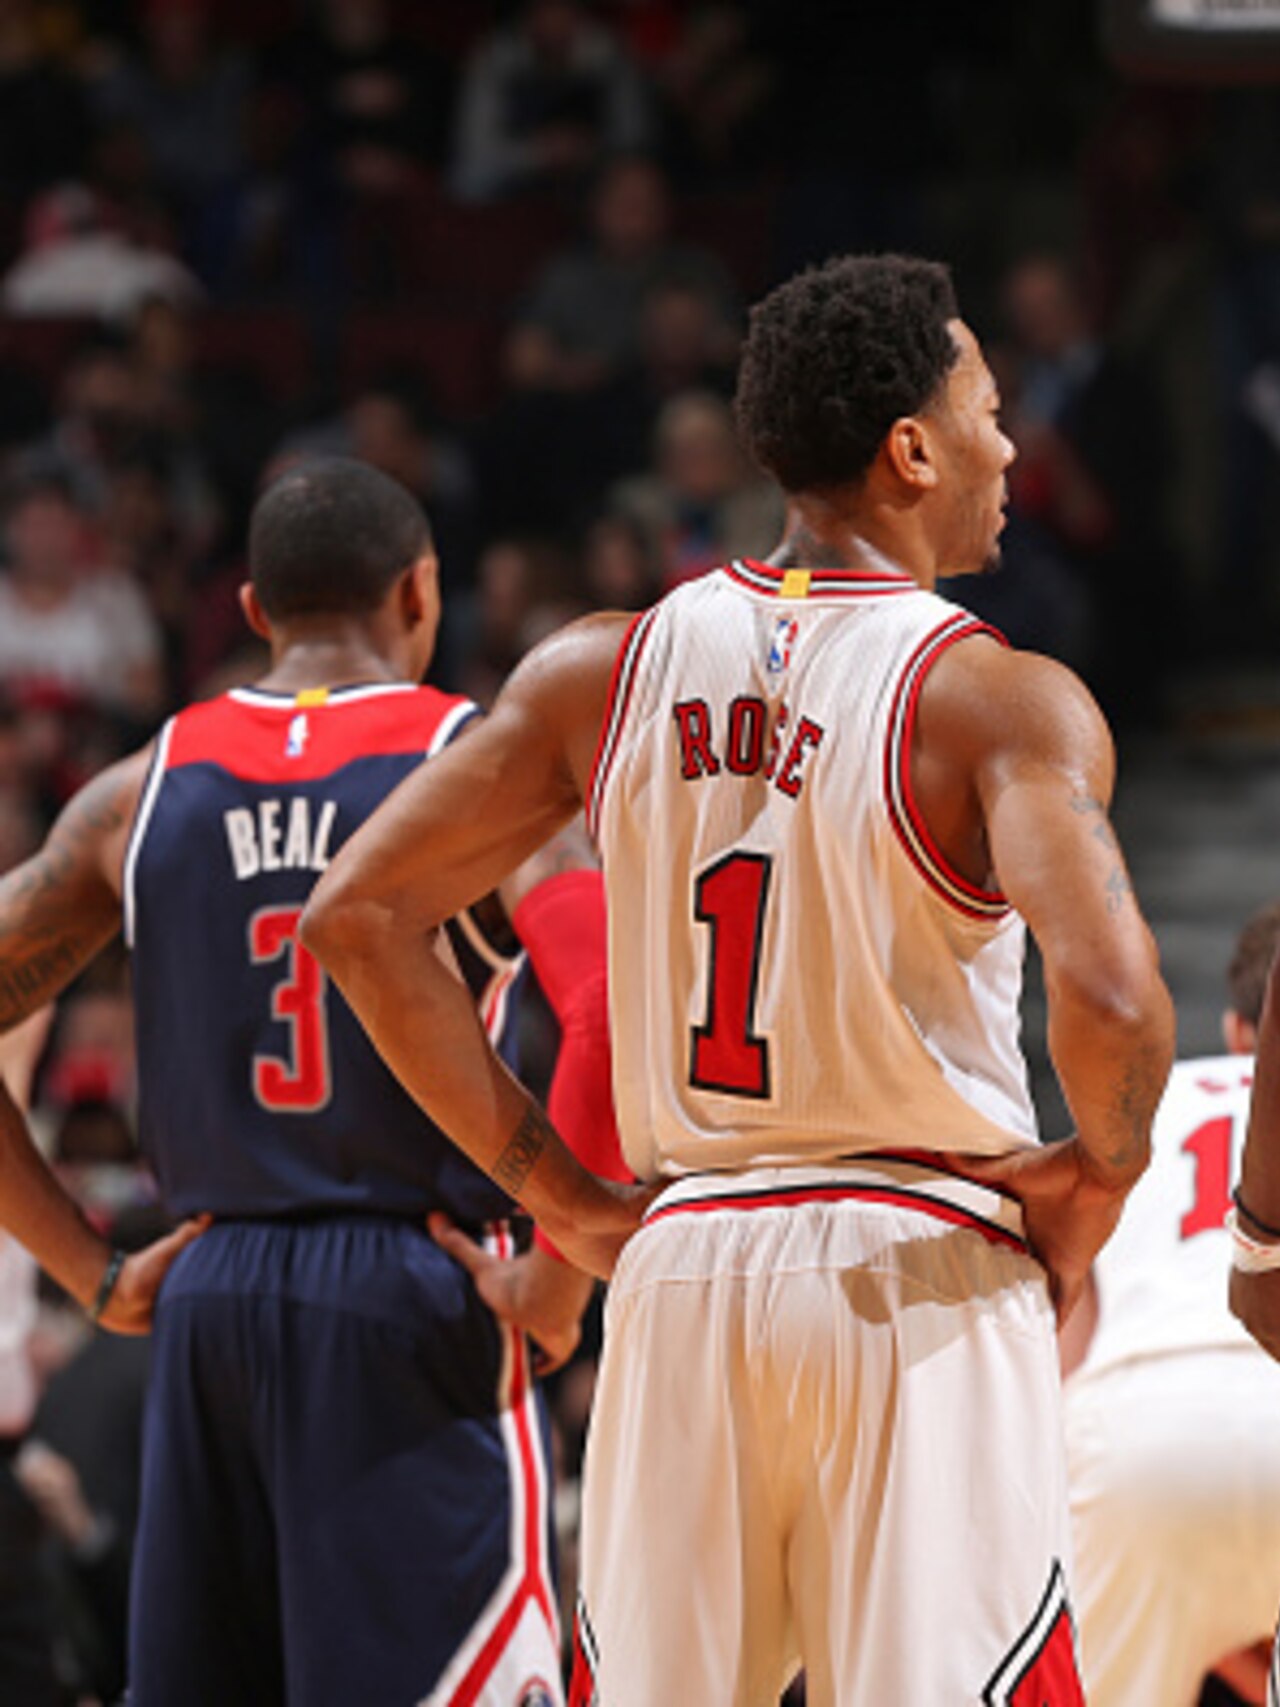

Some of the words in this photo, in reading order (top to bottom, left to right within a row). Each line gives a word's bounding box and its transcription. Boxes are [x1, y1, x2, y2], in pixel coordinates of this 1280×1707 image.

[224, 796, 337, 881] BEAL
[248, 904, 332, 1113] 3
[689, 848, 774, 1099] 1
